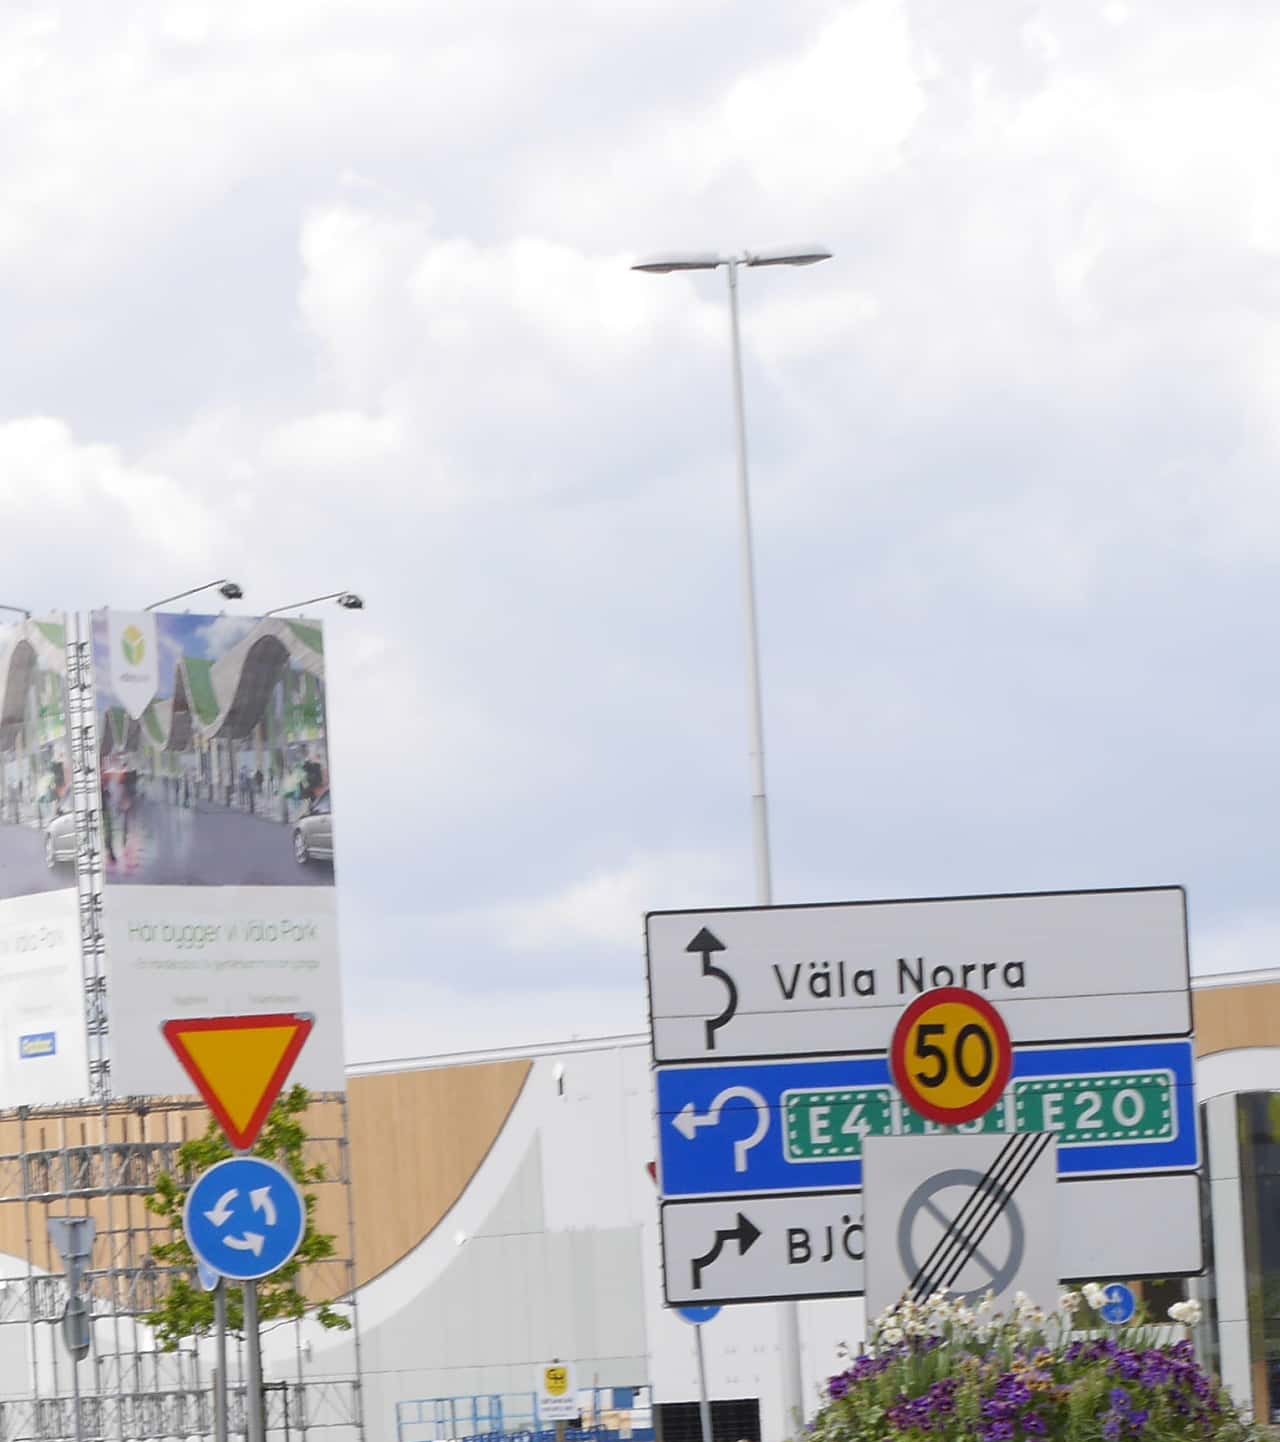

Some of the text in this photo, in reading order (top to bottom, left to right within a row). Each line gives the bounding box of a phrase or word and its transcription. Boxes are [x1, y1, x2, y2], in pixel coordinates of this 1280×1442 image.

[774, 957, 1026, 1000] Väla Norra
[913, 1023, 993, 1089] 50
[809, 1091, 1146, 1144] E4 E20
